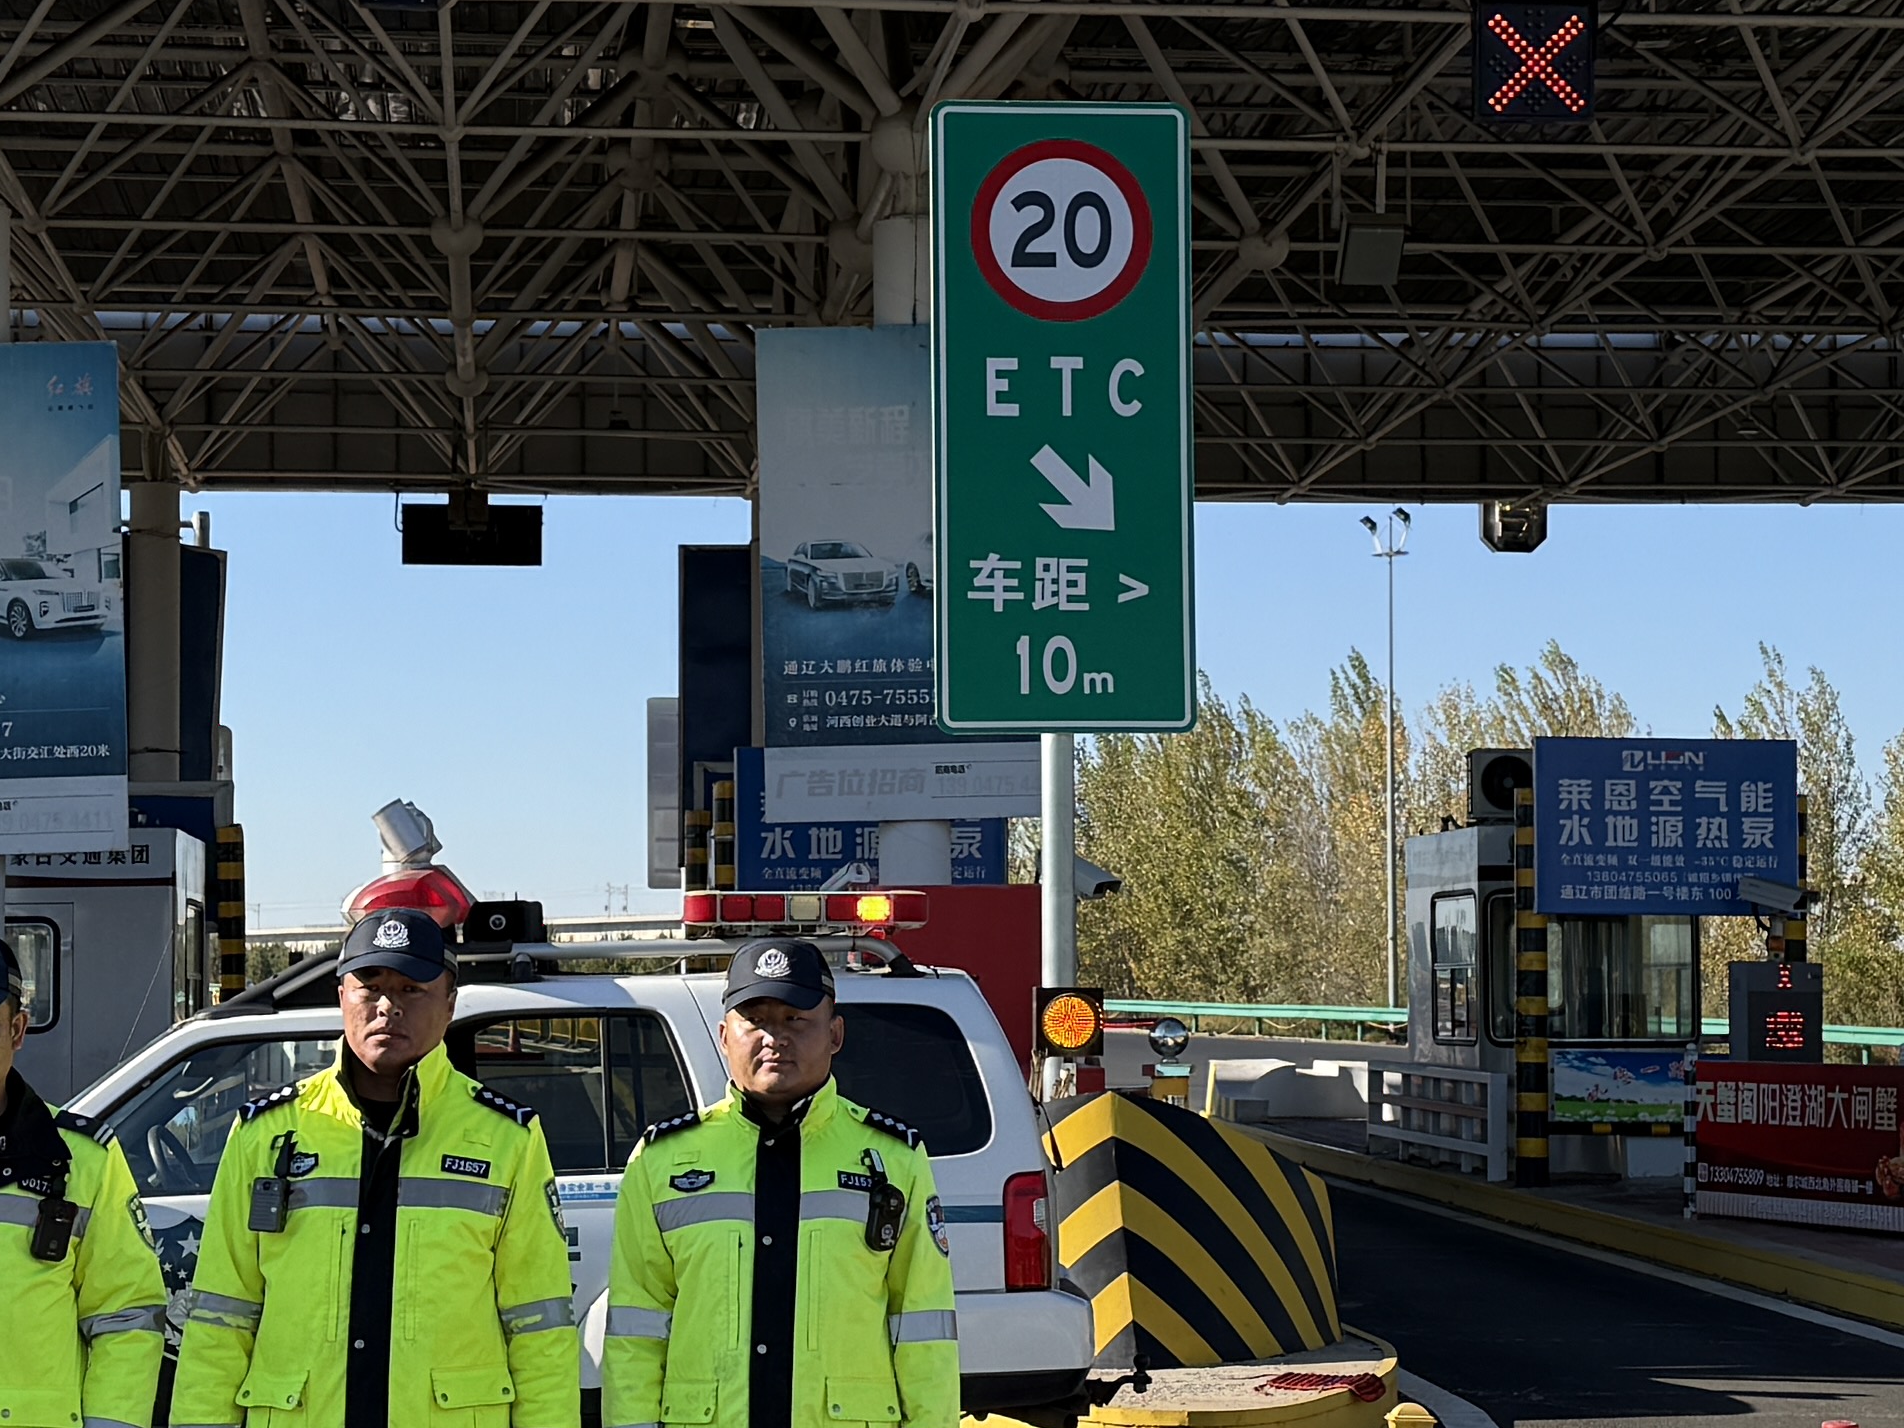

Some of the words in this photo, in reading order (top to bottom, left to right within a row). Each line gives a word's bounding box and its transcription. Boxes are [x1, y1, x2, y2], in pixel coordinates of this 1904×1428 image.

[1010, 190, 1112, 269] 20
[986, 356, 1144, 417] ETC
[967, 552, 1090, 612] 车距
[1016, 635, 1114, 695] 10m
[825, 689, 935, 707] 0475-7555
[1558, 778, 1773, 812] 莱恩空气能
[760, 826, 983, 860] 水地源泵
[1559, 815, 1774, 849] 水地源热泵
[445, 1158, 487, 1174] FJ1657
